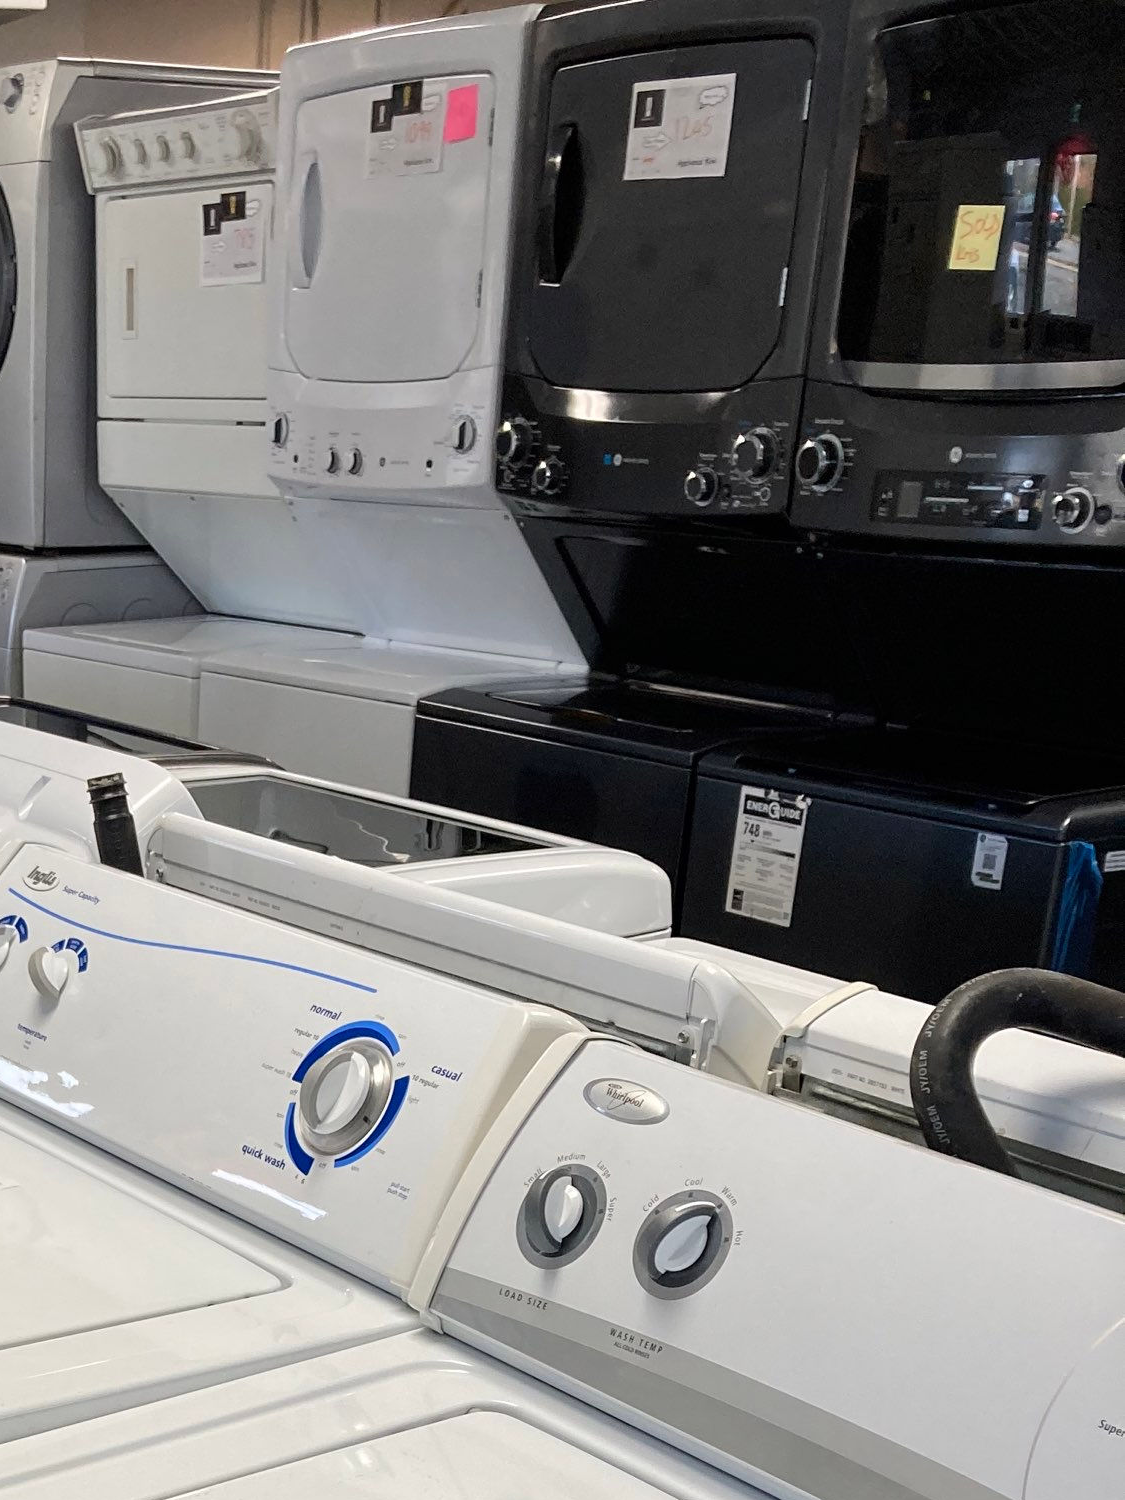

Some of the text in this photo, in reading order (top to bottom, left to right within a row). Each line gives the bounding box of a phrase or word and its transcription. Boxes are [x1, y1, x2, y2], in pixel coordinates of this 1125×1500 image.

[743, 821, 761, 837] 748
[27, 865, 57, 886] Inglis
[309, 1003, 342, 1021] normal
[431, 1064, 464, 1082] casual
[919, 1050, 930, 1095] JY/OEM
[606, 1087, 645, 1108] Whirlpool
[926, 1104, 951, 1145] JY/OEM
[241, 1144, 286, 1170] quick wash
[557, 1153, 587, 1163] Medium
[523, 1168, 544, 1188] Small
[597, 1160, 612, 1180] Large
[684, 1177, 703, 1187] Cool
[642, 1194, 660, 1212] Cold
[721, 1186, 738, 1207] Warm
[607, 1197, 617, 1222] Super
[734, 1230, 743, 1246] Hot
[498, 1288, 548, 1310] LOAD SIZE
[610, 1327, 664, 1354] WASH TEMP
